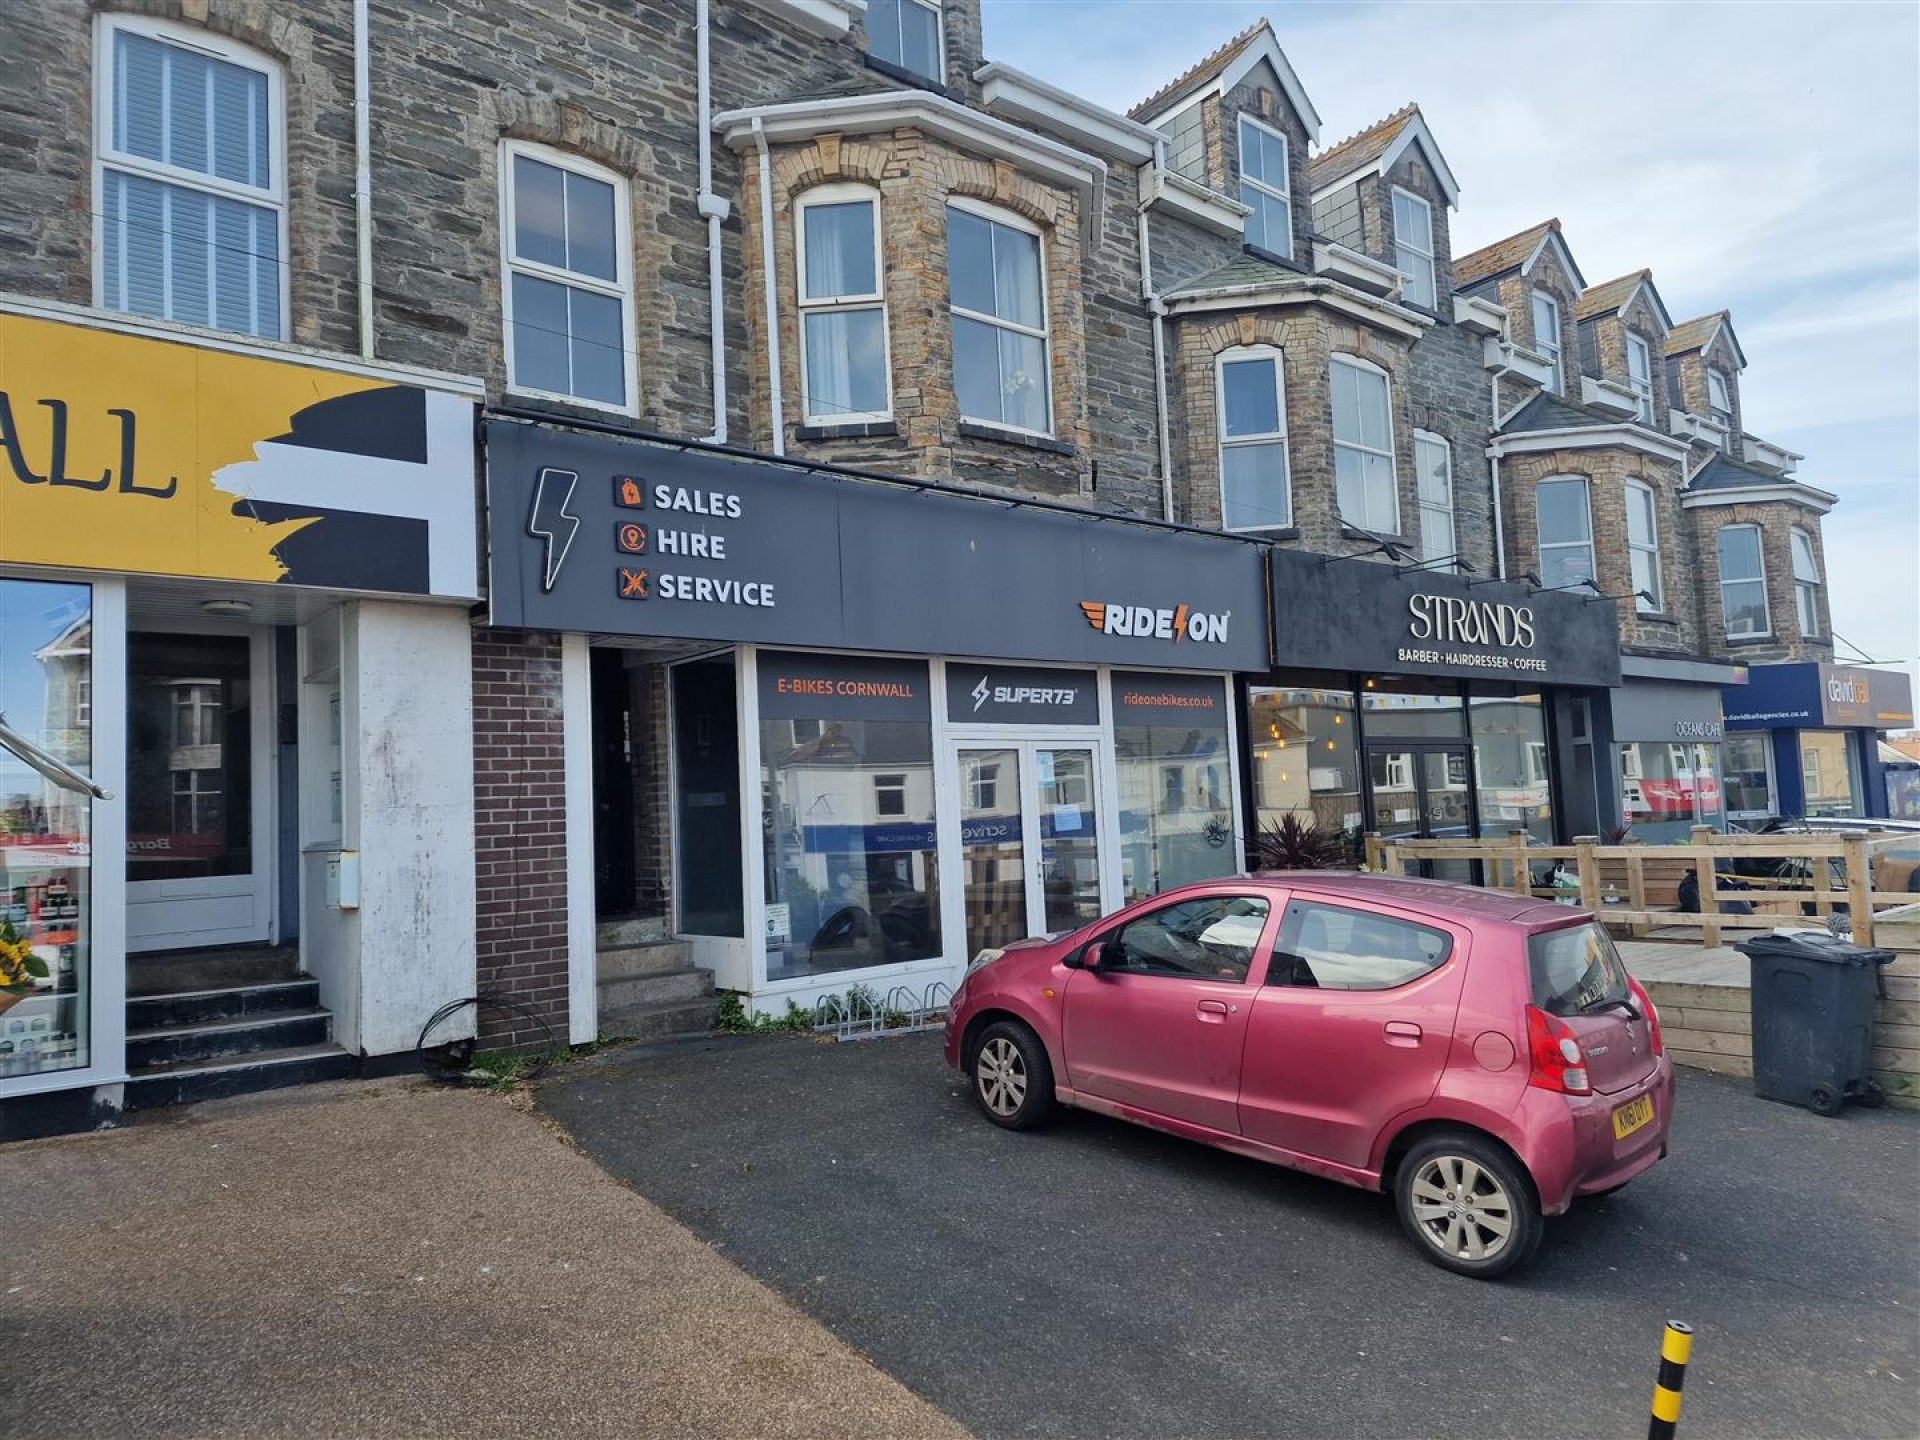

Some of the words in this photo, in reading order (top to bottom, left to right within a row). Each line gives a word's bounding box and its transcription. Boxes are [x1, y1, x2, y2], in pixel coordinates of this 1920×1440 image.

[655, 484, 741, 518] SALES
[657, 528, 726, 560] HIRE
[659, 574, 776, 607] SERVICE
[1104, 603, 1174, 639] RIDE
[1188, 612, 1229, 643] ON
[1409, 593, 1535, 648] STRANDS
[1398, 648, 1439, 664] BARBER
[1446, 652, 1509, 668] HAIRDRESSER
[1514, 658, 1547, 672] COFFEE
[778, 678, 833, 694] E-BIKES
[837, 681, 913, 697] CORNWALL
[994, 687, 1074, 704] SUPER73
[1124, 691, 1214, 707] rideonebikes.co.uk
